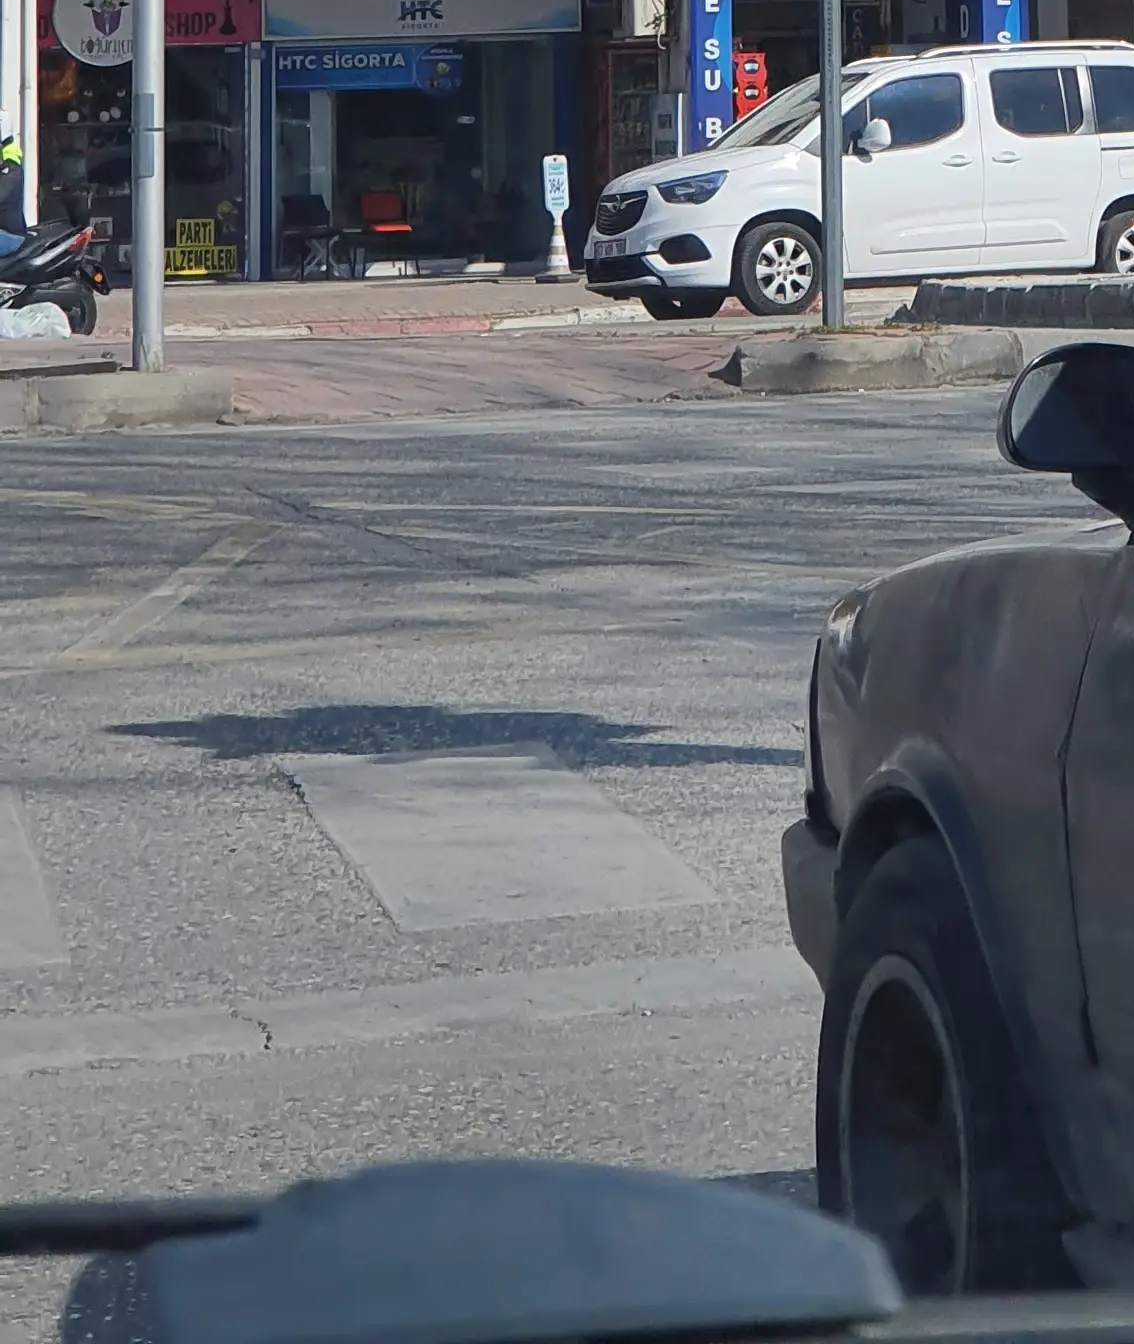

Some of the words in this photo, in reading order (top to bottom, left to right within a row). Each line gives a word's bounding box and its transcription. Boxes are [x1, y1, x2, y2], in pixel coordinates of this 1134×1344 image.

[399, 0, 443, 22] HTC
[165, 12, 216, 37] SHOP
[278, 53, 316, 71] HTC
[325, 50, 406, 70] SİGORTA
